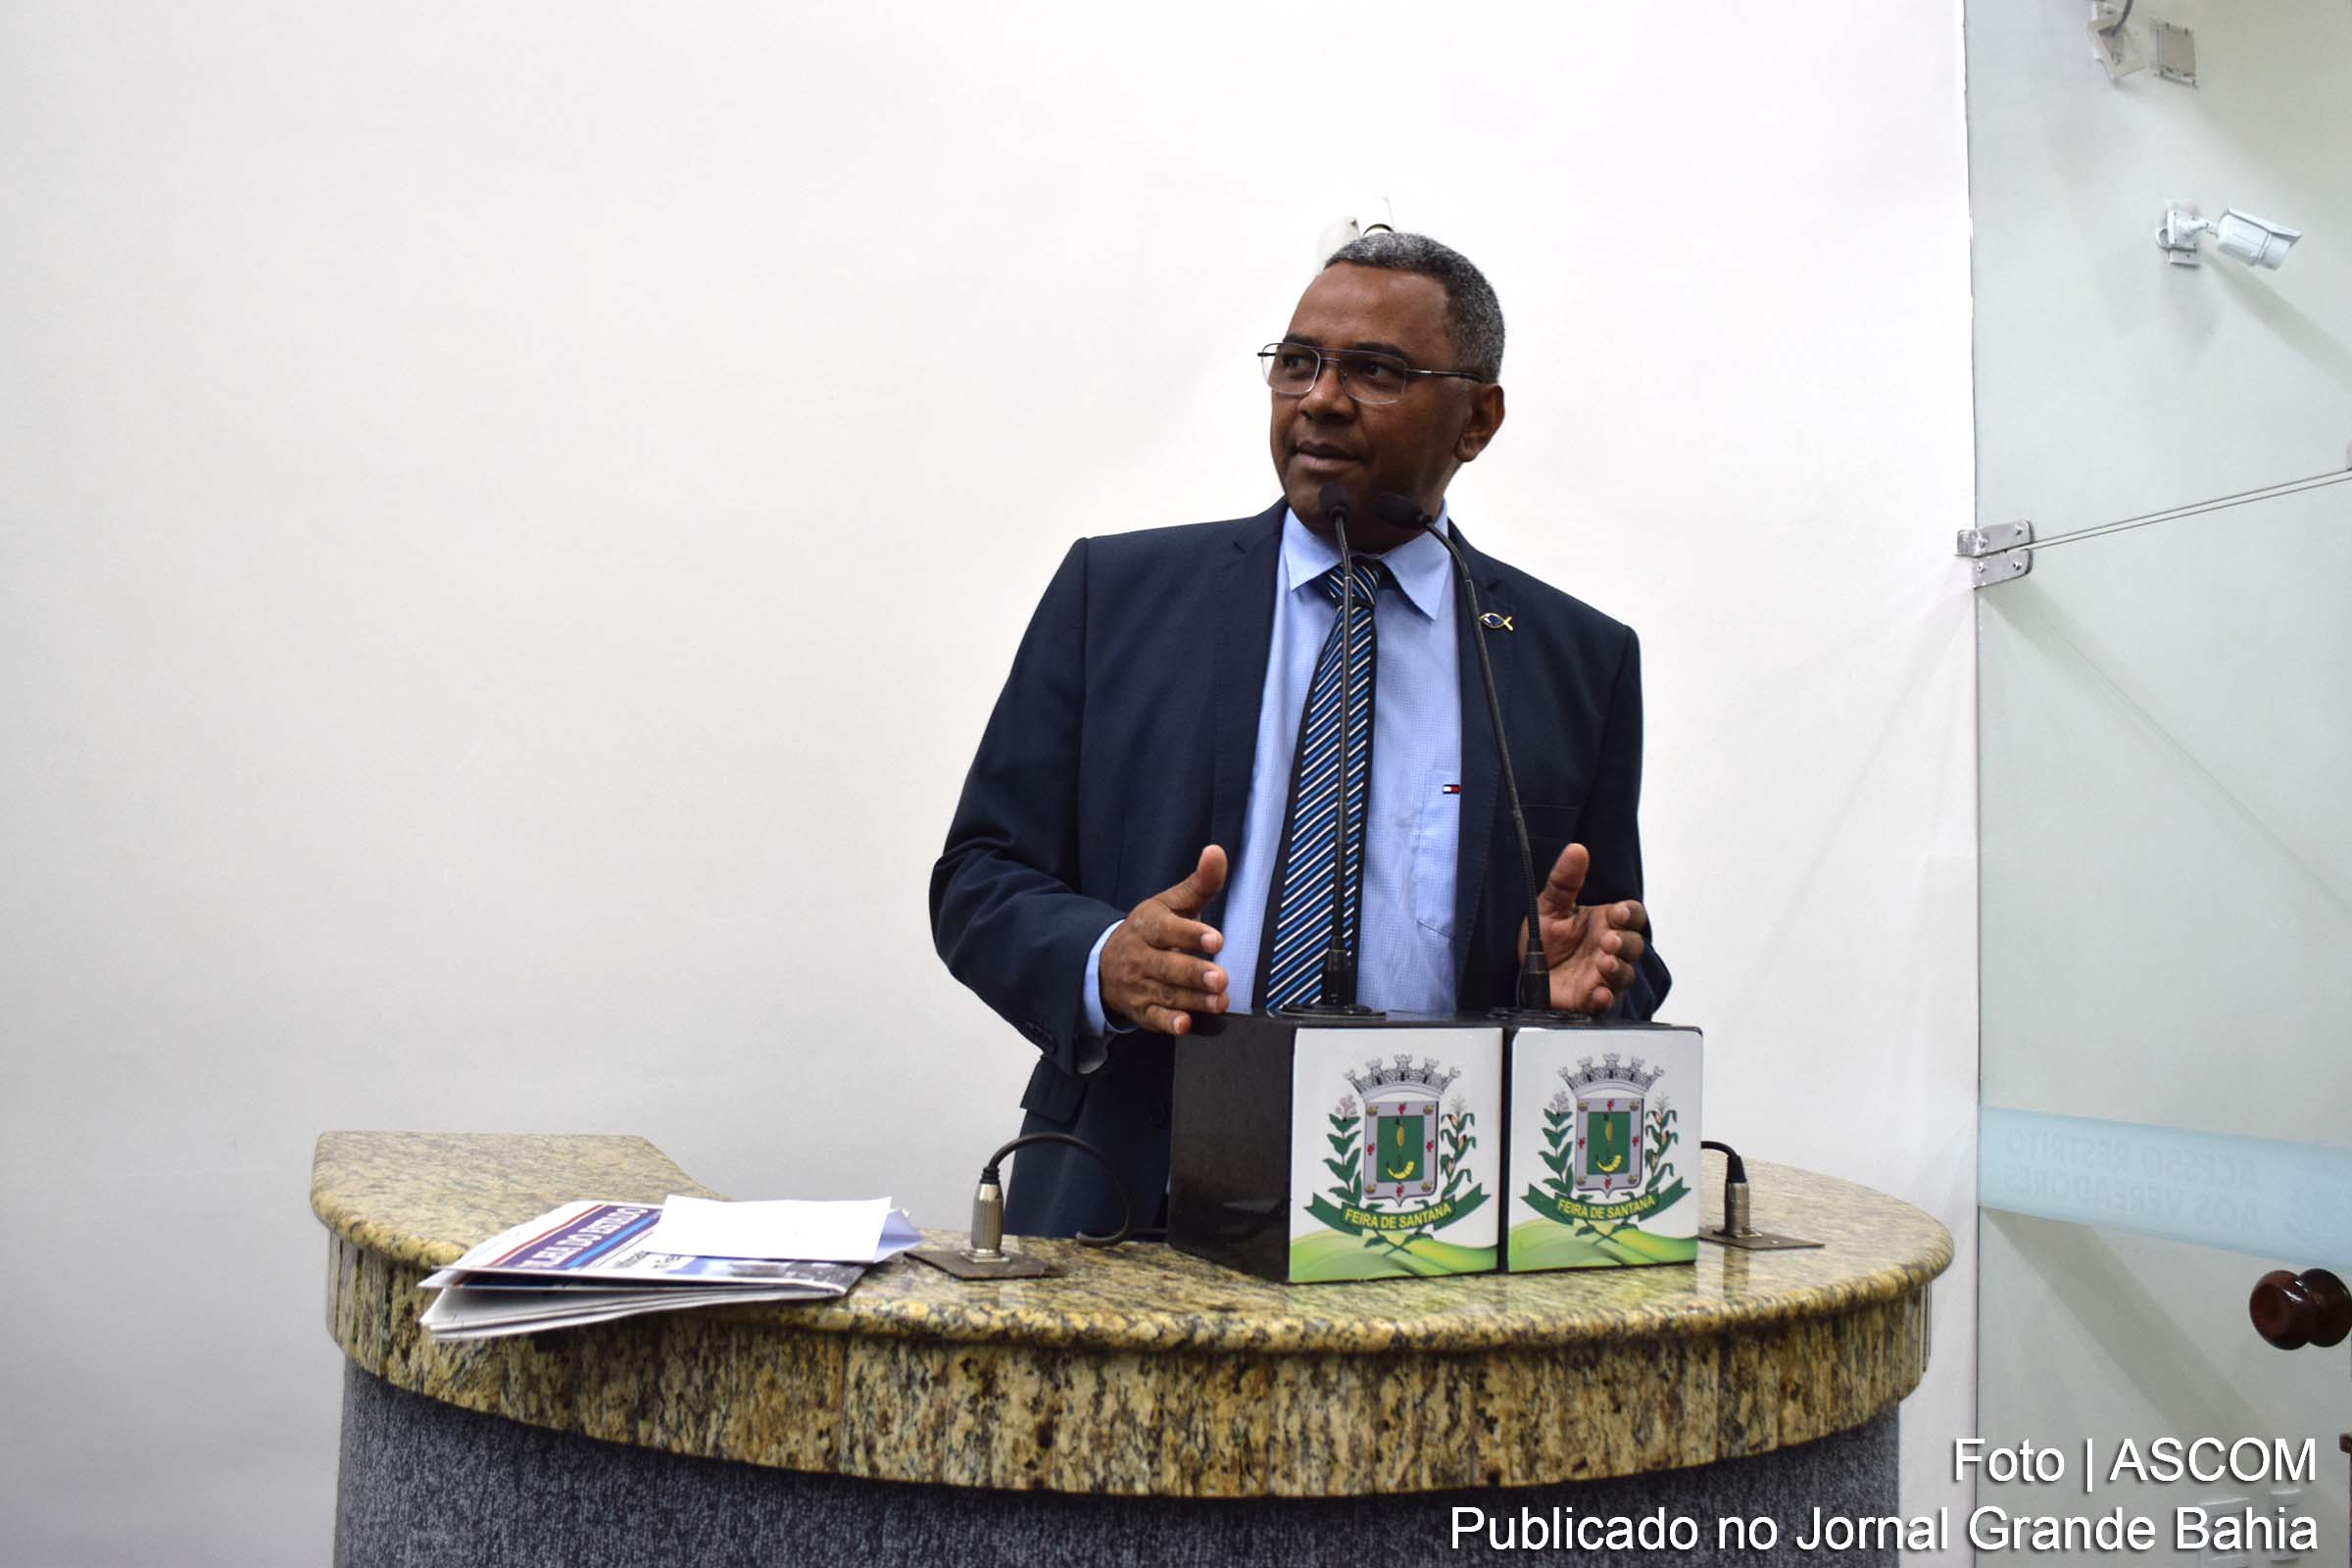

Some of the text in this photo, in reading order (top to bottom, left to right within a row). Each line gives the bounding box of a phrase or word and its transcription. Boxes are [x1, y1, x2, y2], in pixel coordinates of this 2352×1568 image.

[1345, 1201, 1452, 1229] FEIRA DE SANTANA
[1557, 1195, 1656, 1219] FEIRA DE SANTANA
